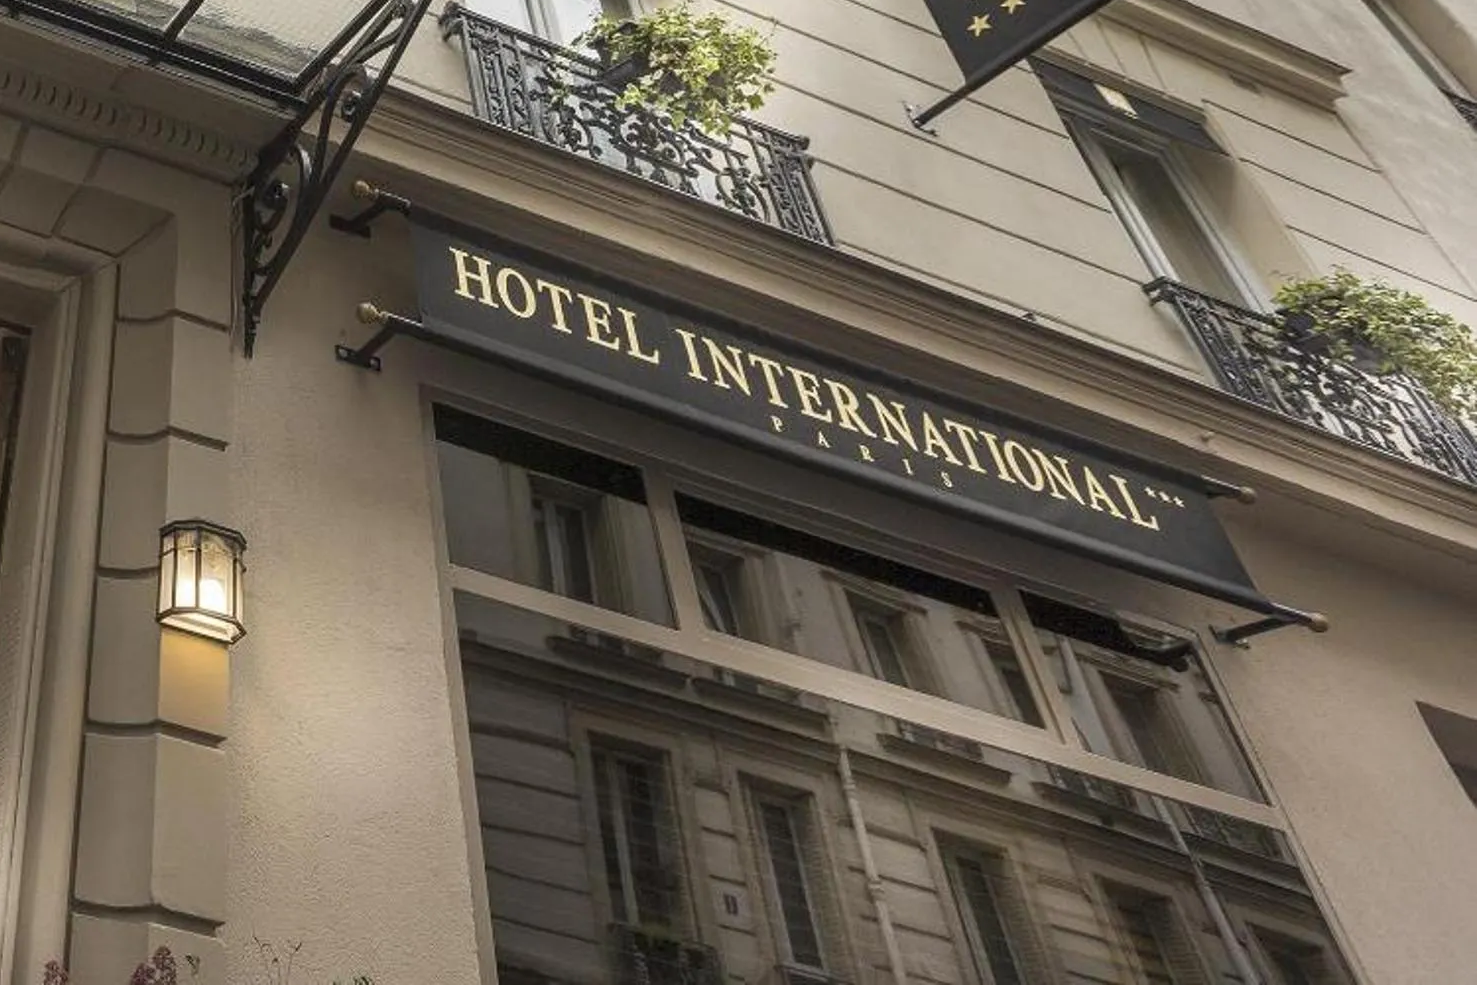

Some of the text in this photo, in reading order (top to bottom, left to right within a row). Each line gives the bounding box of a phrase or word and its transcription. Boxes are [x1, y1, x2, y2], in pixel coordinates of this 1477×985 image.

[448, 246, 1160, 531] HOTEL INTERNATIONAL
[770, 415, 953, 489] PARIS
